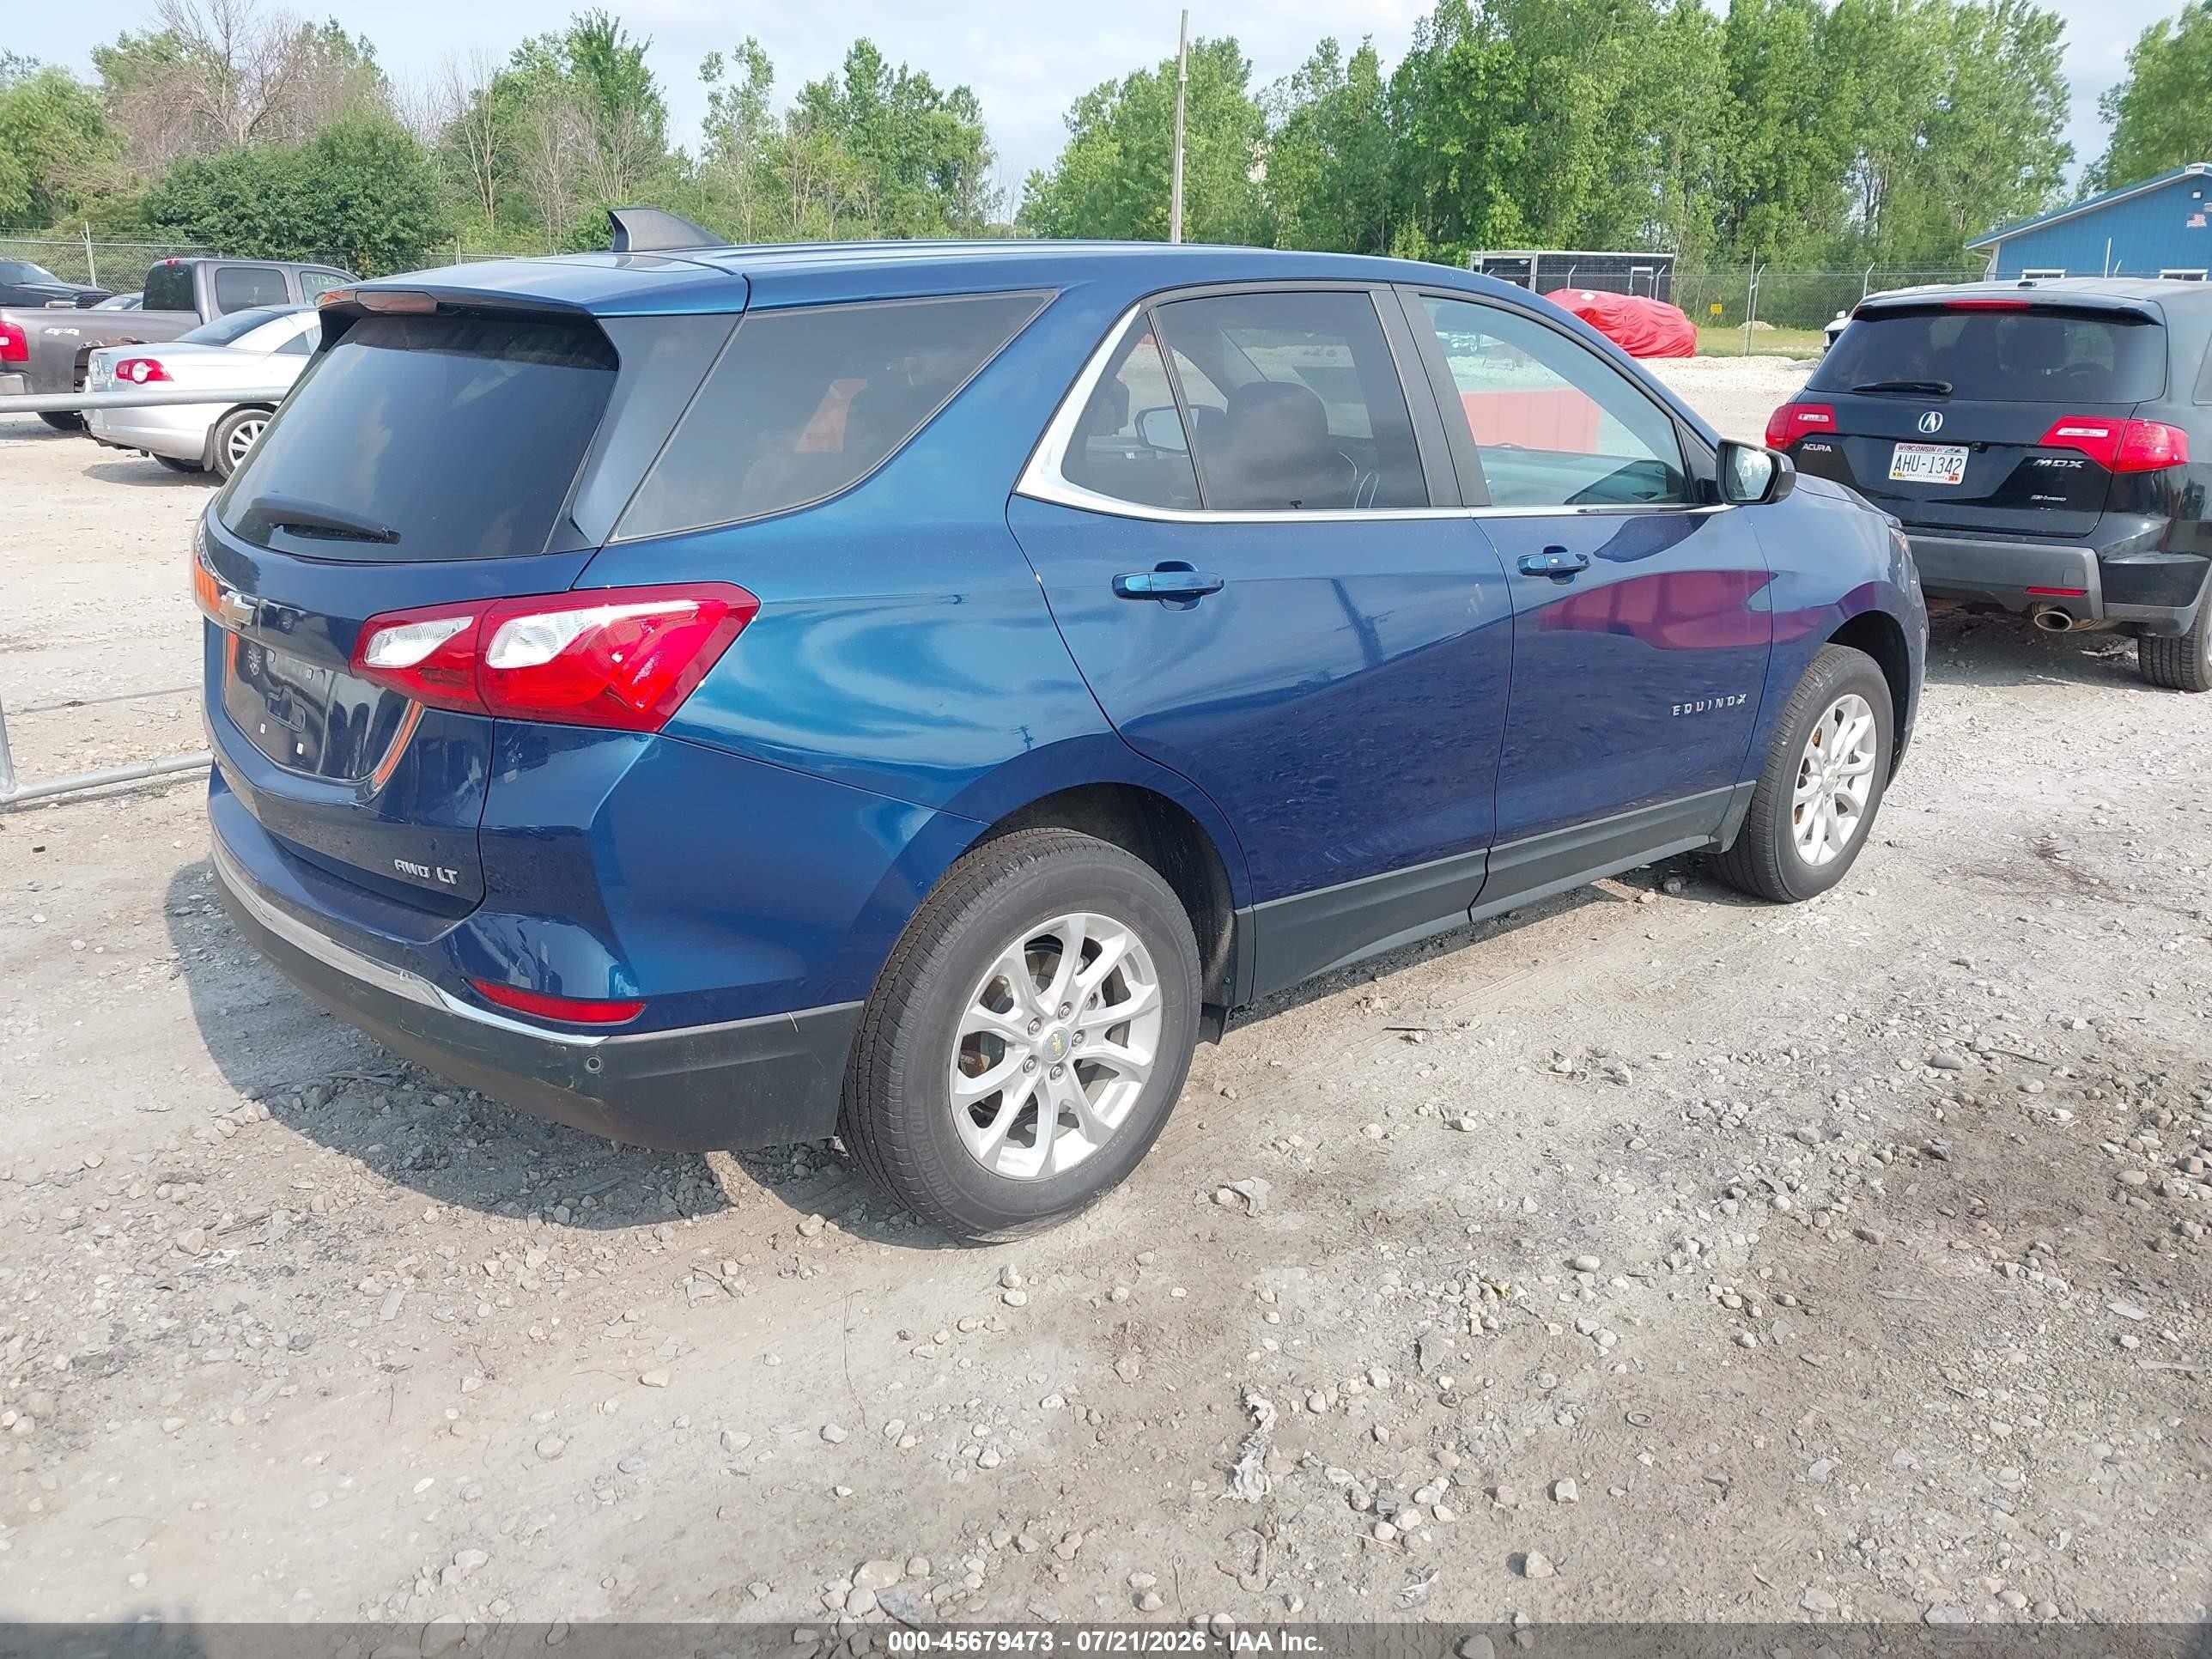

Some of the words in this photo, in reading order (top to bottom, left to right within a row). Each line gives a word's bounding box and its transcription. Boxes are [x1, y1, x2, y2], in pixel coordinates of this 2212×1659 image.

[1802, 443, 1832, 453] ACURA
[1893, 453, 1963, 477] AHU-1342
[2033, 459, 2086, 469] MDX
[1672, 694, 1747, 716] EQUINOX
[393, 859, 431, 878] AWD
[436, 866, 459, 885] LT
